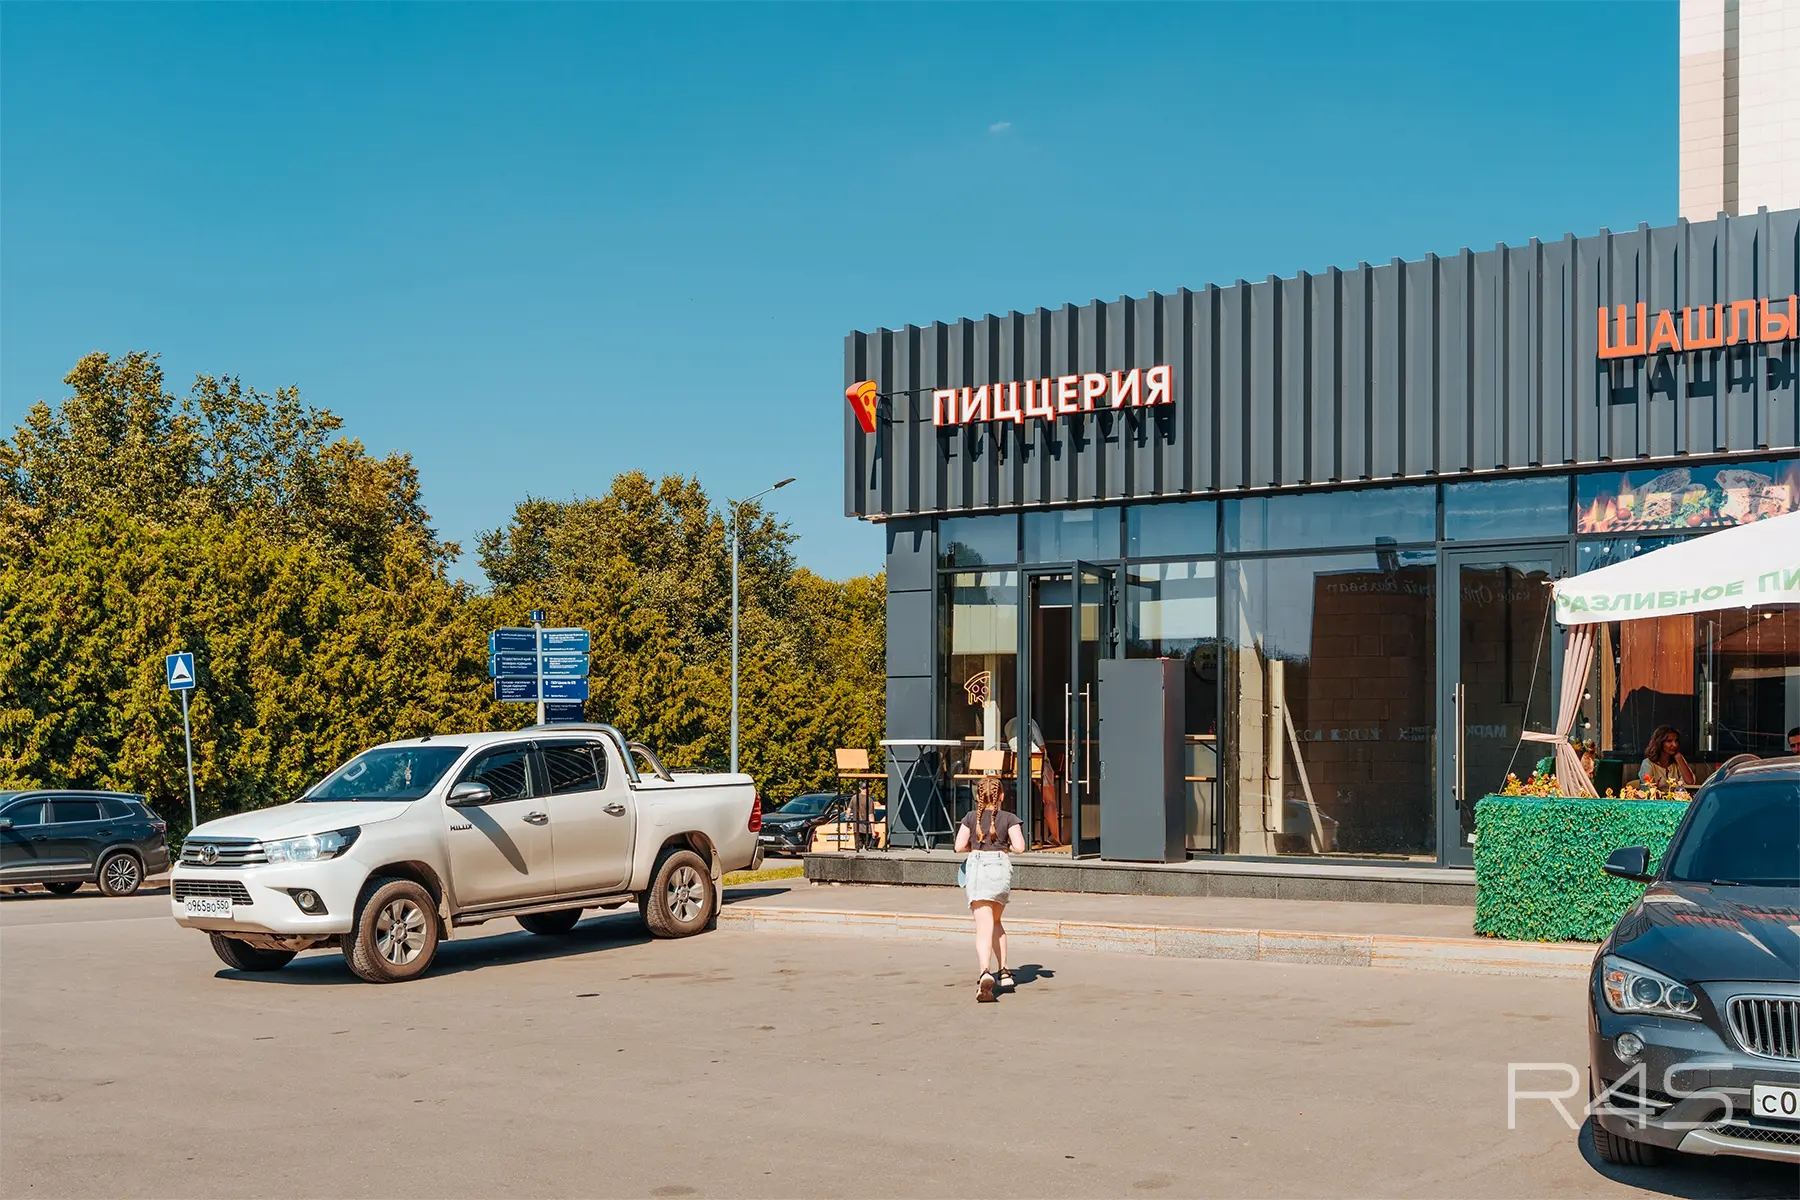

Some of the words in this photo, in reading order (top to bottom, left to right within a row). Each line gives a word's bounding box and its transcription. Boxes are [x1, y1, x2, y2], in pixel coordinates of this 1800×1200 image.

[1598, 294, 1798, 359] ШАШЛЫ
[933, 365, 1173, 426] ПИЦЦЕРИЯ
[1556, 580, 1744, 613] РАЗЛИВНОЕ
